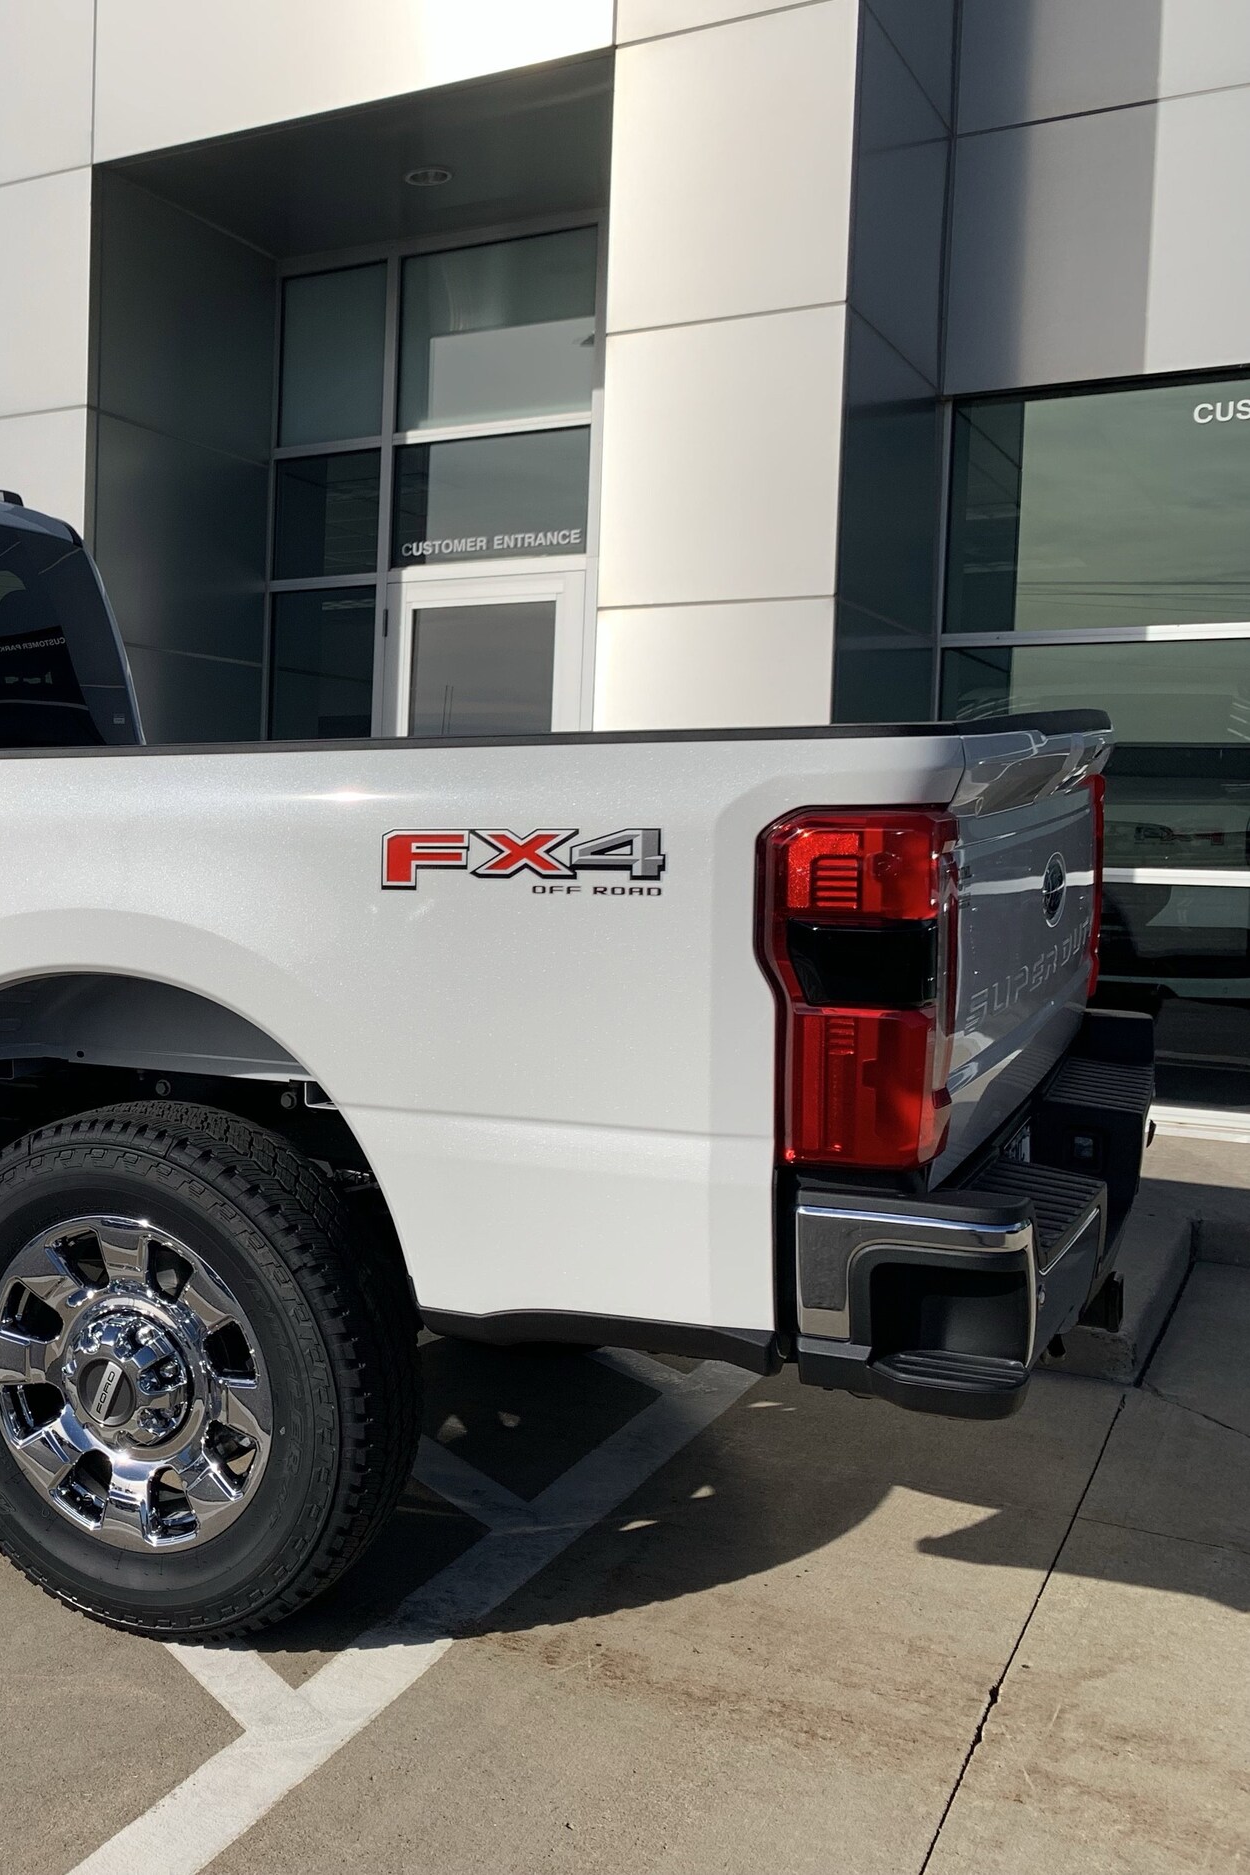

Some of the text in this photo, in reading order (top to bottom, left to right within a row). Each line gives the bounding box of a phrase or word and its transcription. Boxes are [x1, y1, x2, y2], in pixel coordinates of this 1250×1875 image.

[1193, 399, 1250, 424] CUS
[401, 528, 582, 557] CUSTOMER ENTRANCE
[381, 827, 666, 891] FX4
[531, 885, 663, 897] OFF ROAD
[963, 943, 1058, 1037] SUPER
[95, 1370, 116, 1415] FORD
